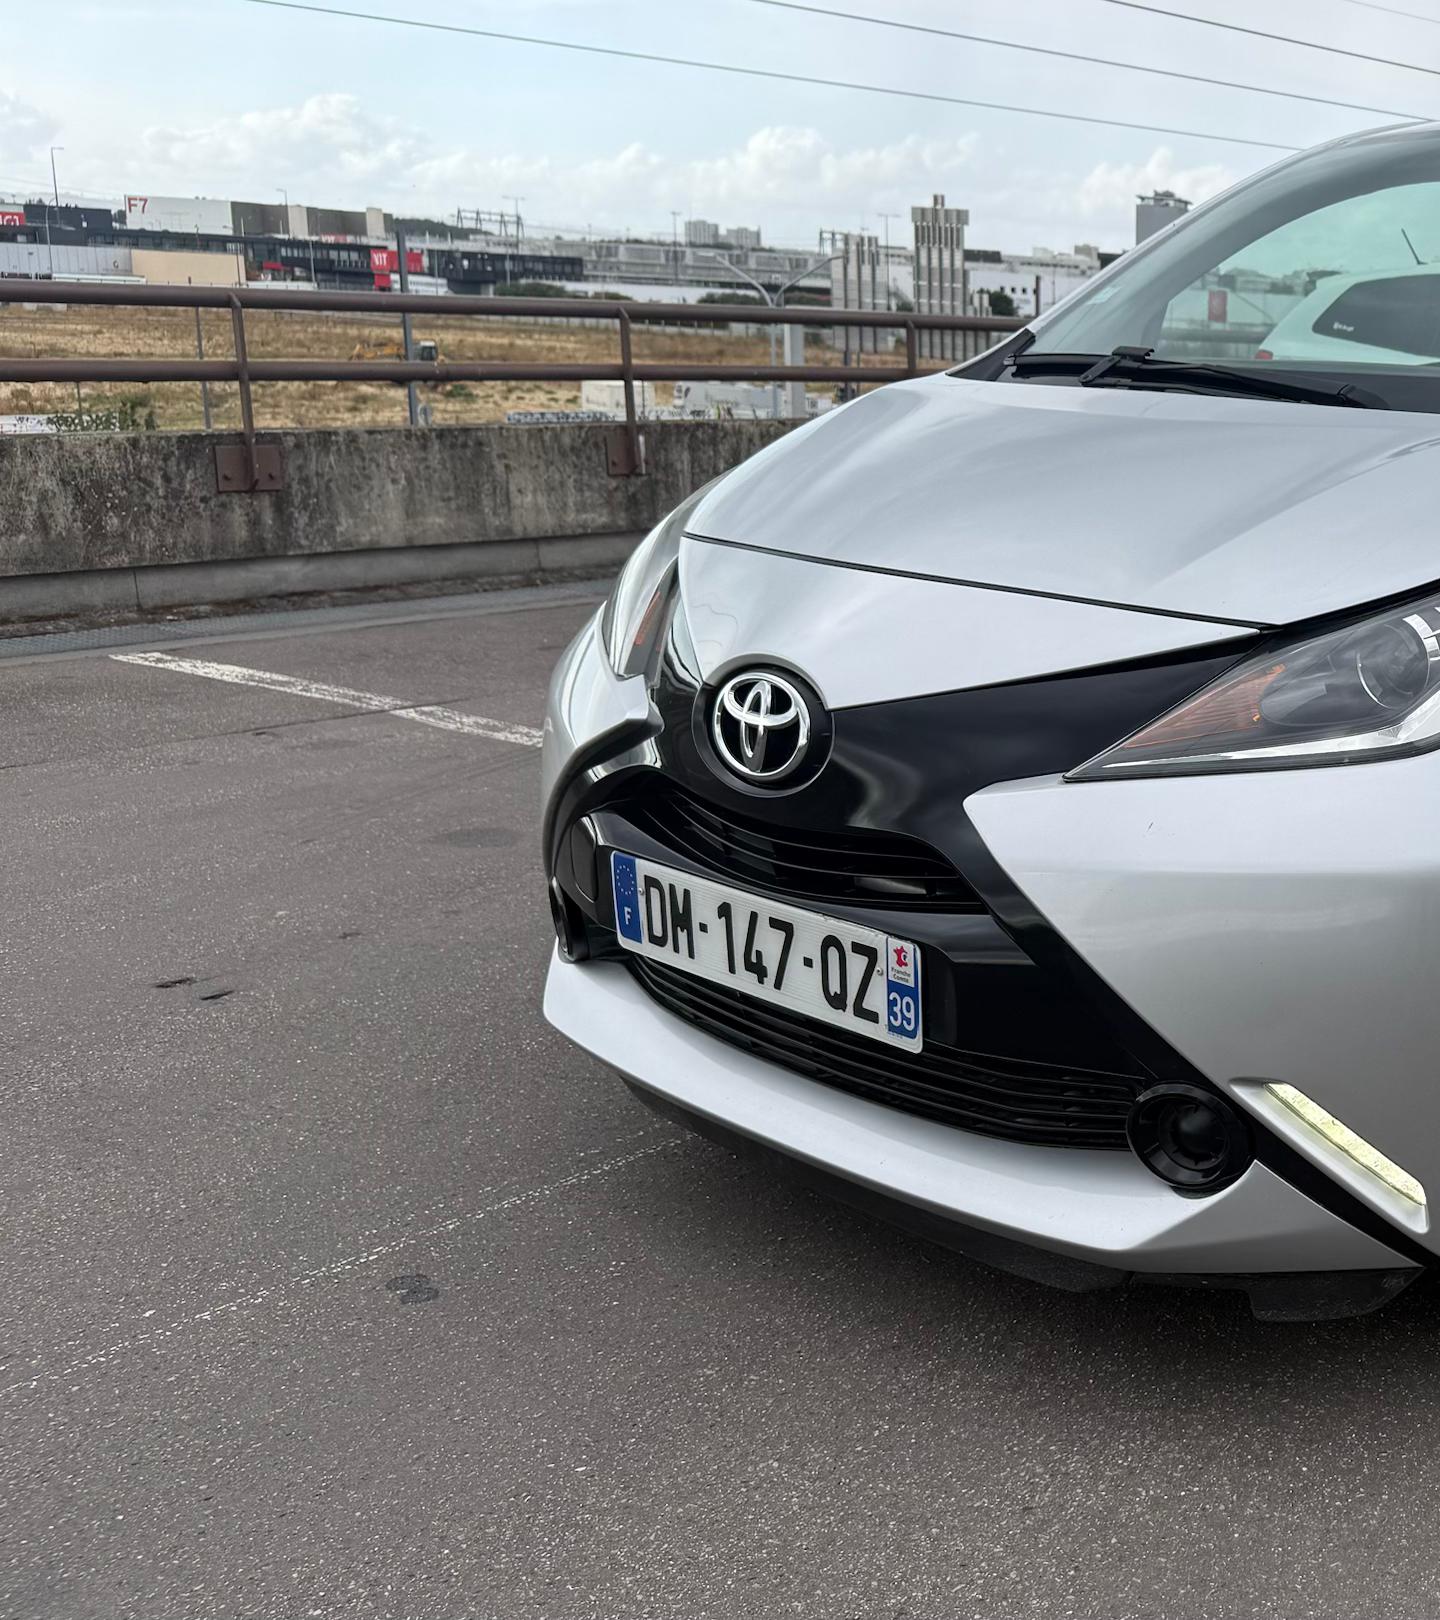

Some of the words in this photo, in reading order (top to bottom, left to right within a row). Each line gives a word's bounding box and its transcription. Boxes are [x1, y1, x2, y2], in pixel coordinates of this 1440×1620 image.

[127, 197, 148, 214] F7
[624, 906, 632, 925] F
[643, 874, 880, 1024] DM-147-QZ
[889, 991, 916, 1032] 39
